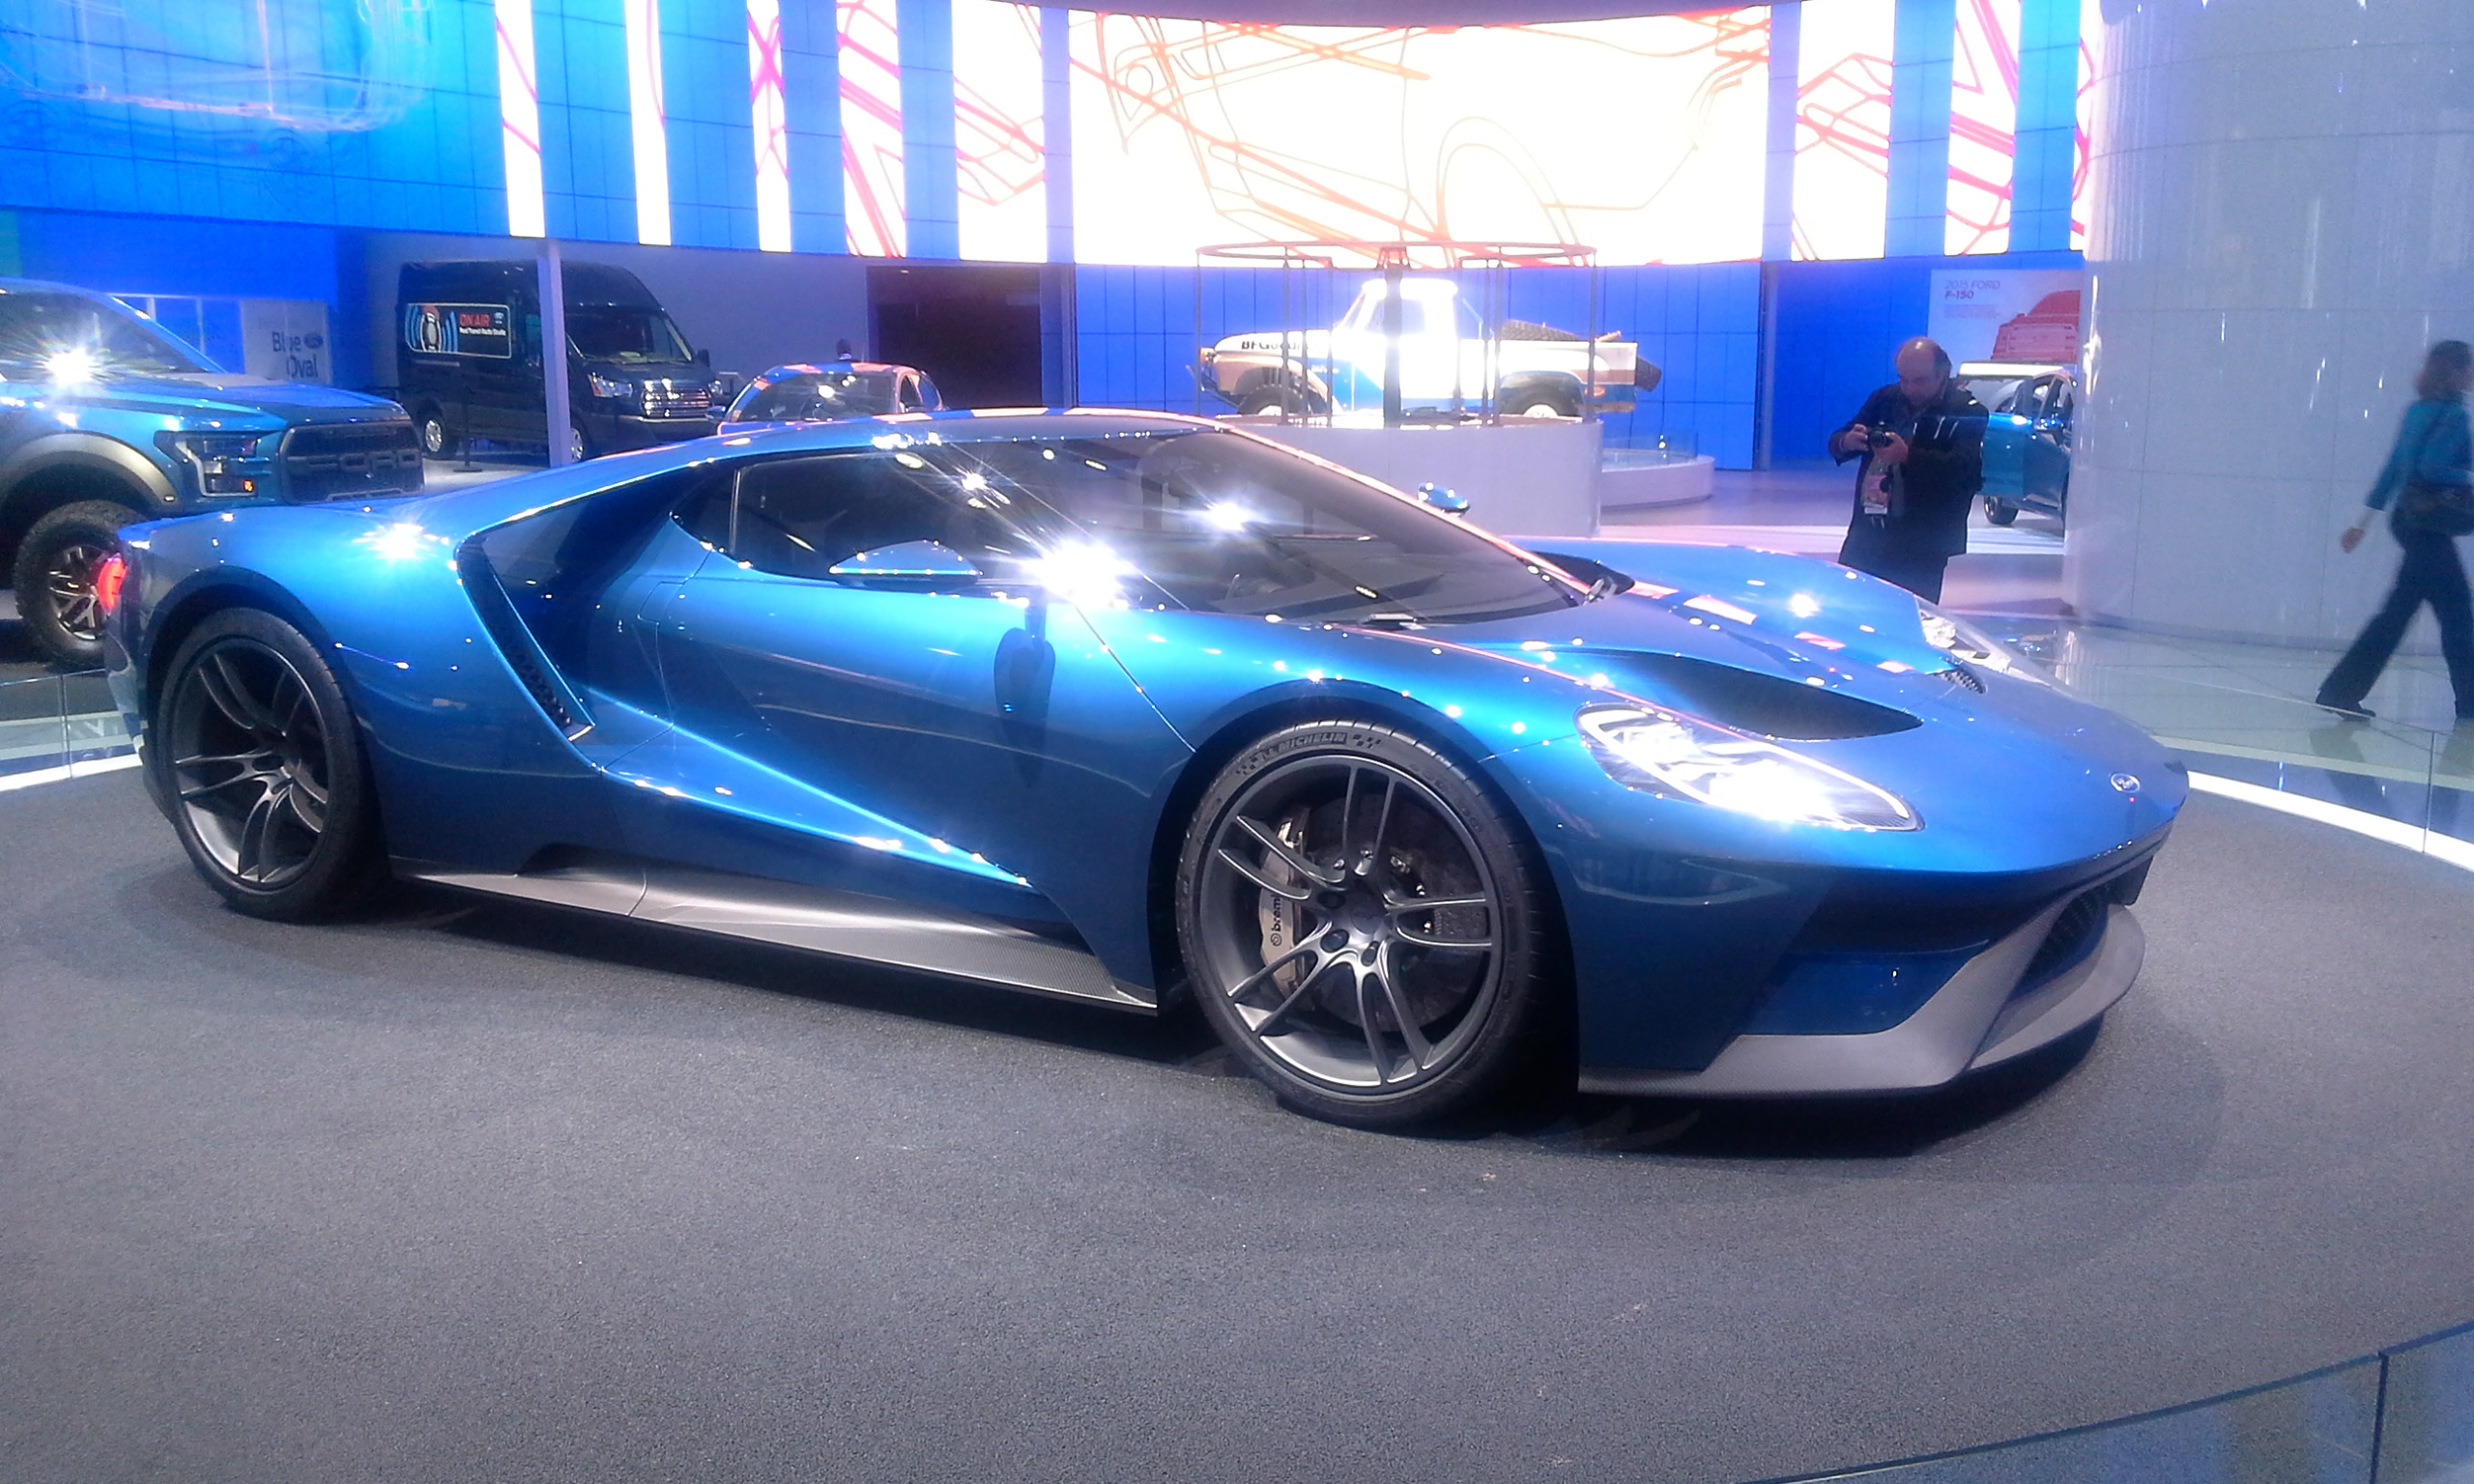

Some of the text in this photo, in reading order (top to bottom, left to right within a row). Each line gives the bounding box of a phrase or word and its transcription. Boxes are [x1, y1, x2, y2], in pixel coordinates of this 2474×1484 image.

[1971, 279, 2001, 290] FORD
[1944, 290, 1974, 300] F-150
[459, 313, 474, 327] ON
[475, 313, 491, 327] AIR
[285, 354, 319, 378] Oval
[1278, 732, 1346, 754] MICHELIN
[1271, 894, 1281, 932] brem
